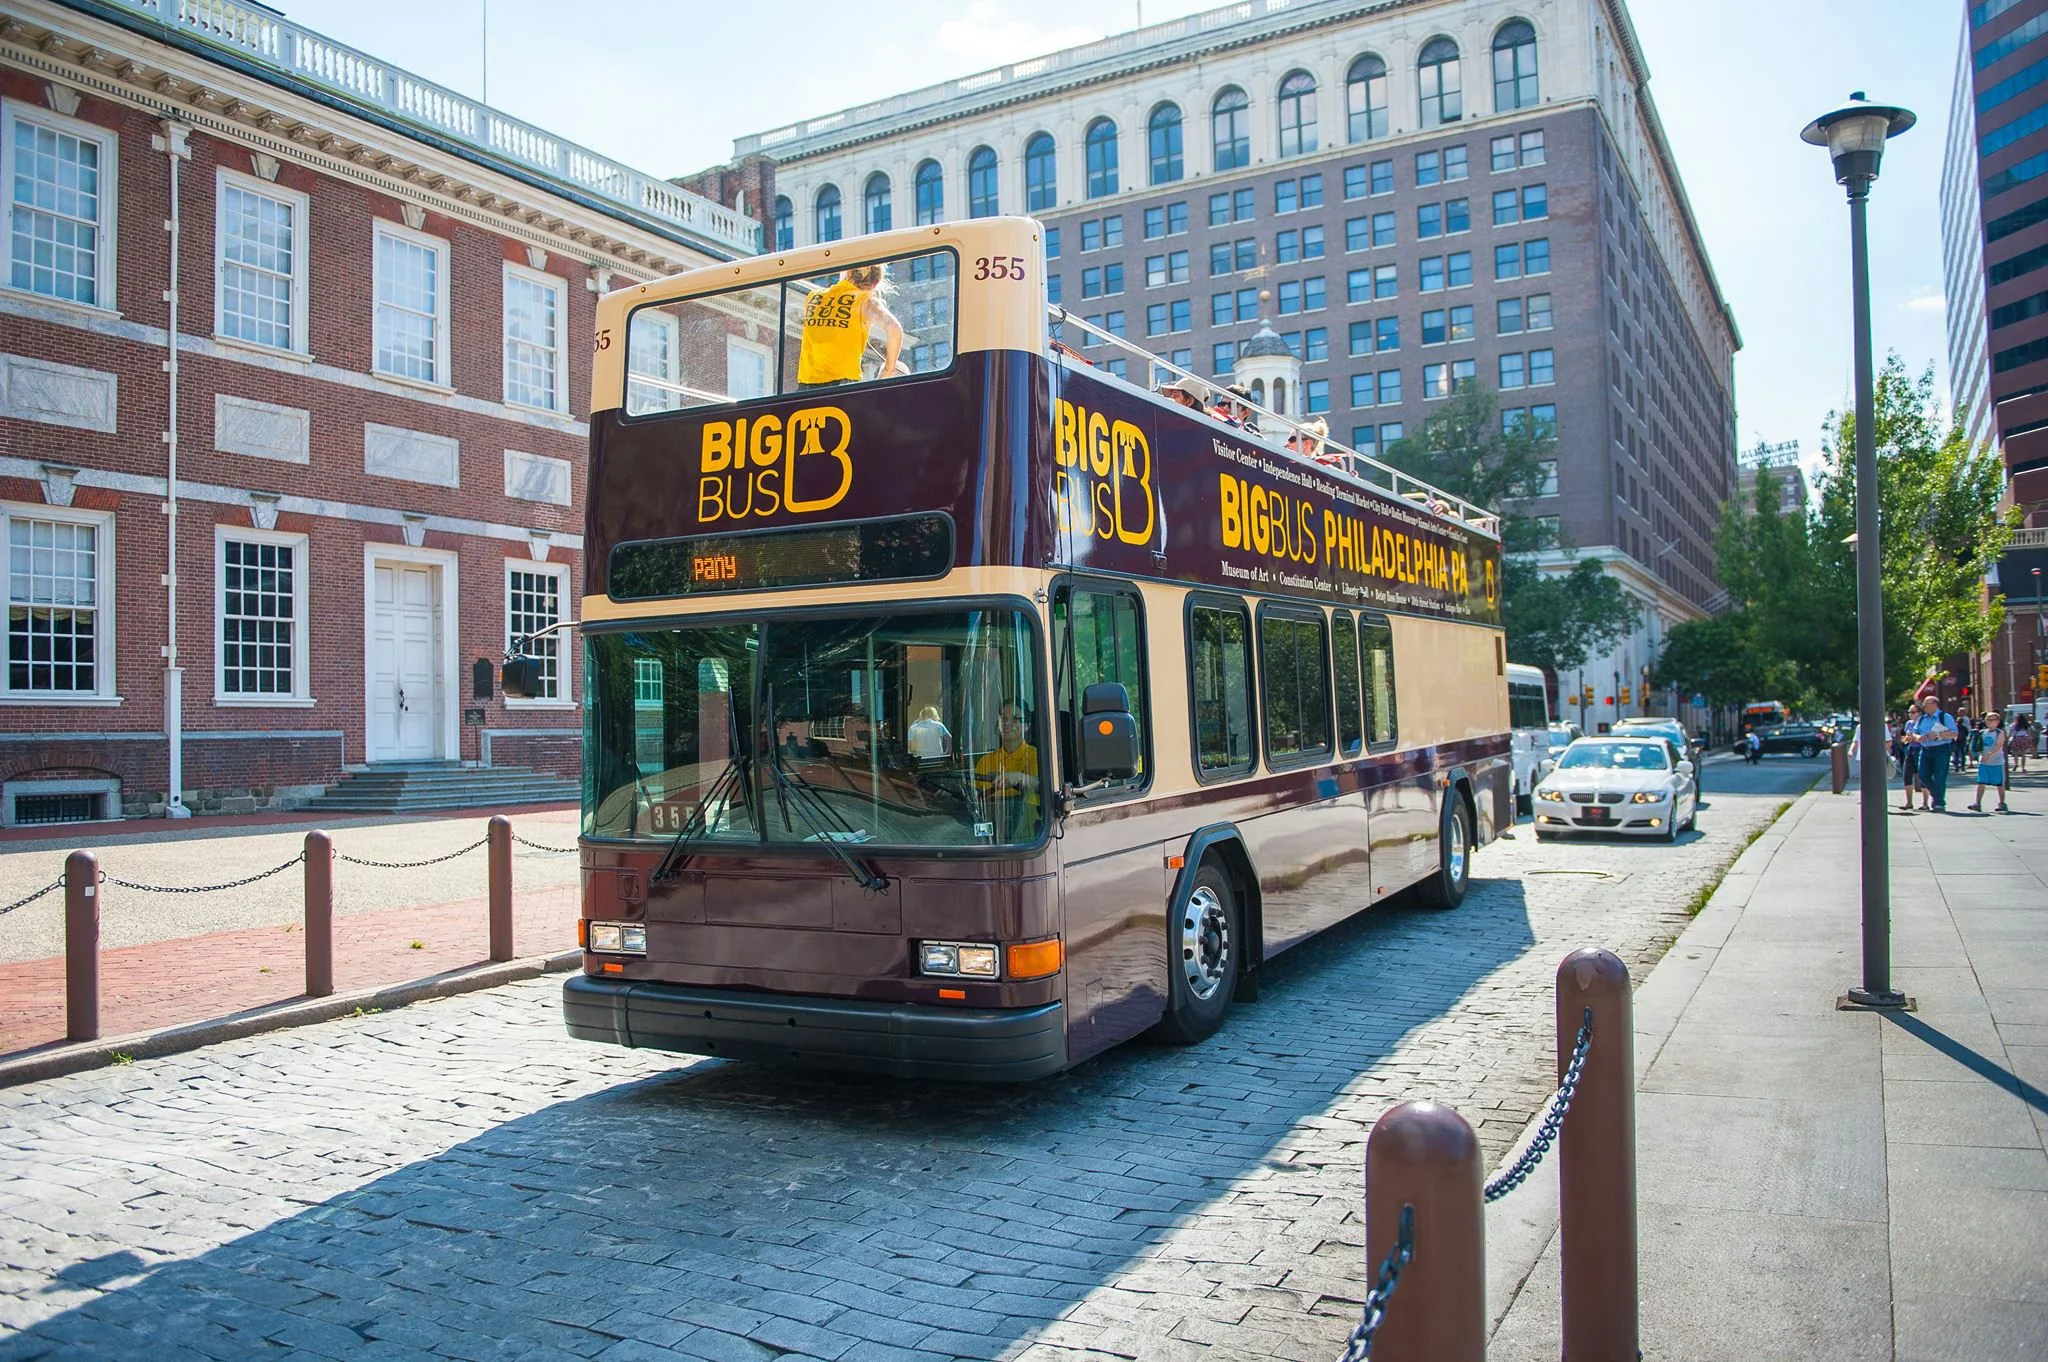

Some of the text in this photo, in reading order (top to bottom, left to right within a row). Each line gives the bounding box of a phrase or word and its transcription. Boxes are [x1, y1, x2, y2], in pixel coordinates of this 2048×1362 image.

[974, 256, 1025, 281] 355
[805, 305, 852, 320] BUS
[808, 294, 856, 307] BIG
[701, 414, 783, 473] BIG
[1055, 397, 1111, 477] BIG
[698, 469, 780, 523] BUS
[1213, 438, 1236, 460] Visitor
[1236, 448, 1258, 468] Center
[1263, 458, 1301, 485] Independence
[1301, 472, 1313, 489] Hall
[1316, 478, 1336, 500] Reading
[1335, 485, 1356, 504] Terminal
[1355, 492, 1371, 509] Market
[1056, 471, 1114, 540] BUS
[1221, 560, 1250, 580] Museum
[1250, 567, 1258, 580] of
[1259, 567, 1269, 583] Art
[1279, 571, 1313, 590] Constitution
[1313, 577, 1332, 592] Center
[1341, 582, 1359, 599] Liberty
[1323, 508, 1449, 591] PHILADELPHIA
[1450, 550, 1469, 596] PA
